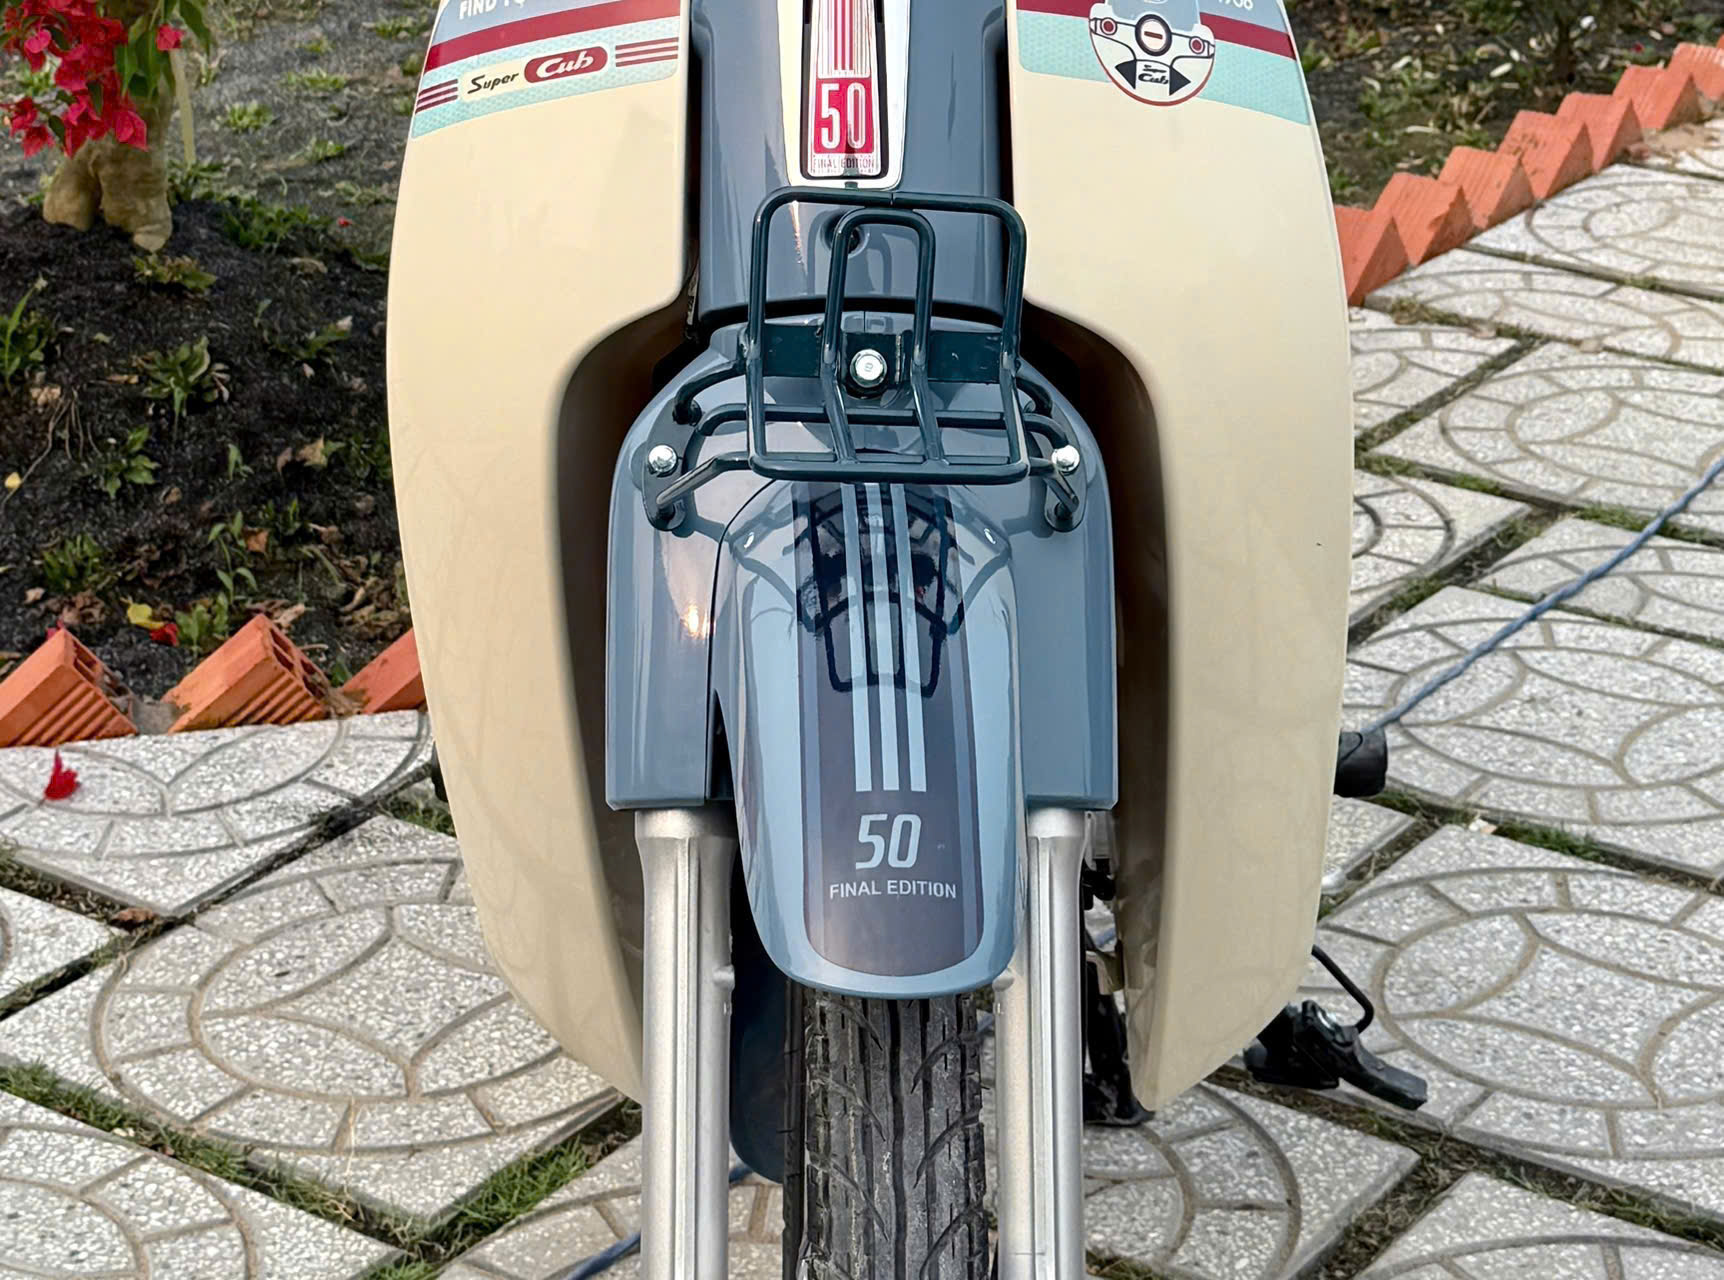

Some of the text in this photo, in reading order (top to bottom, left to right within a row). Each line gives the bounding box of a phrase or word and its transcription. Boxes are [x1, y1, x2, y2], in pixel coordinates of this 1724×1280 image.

[467, 50, 595, 95] Super Cub
[820, 81, 867, 149] 50
[813, 158, 875, 168] FINAL EDITION
[856, 813, 922, 870] 50
[829, 880, 957, 900] FINAL EDITION
